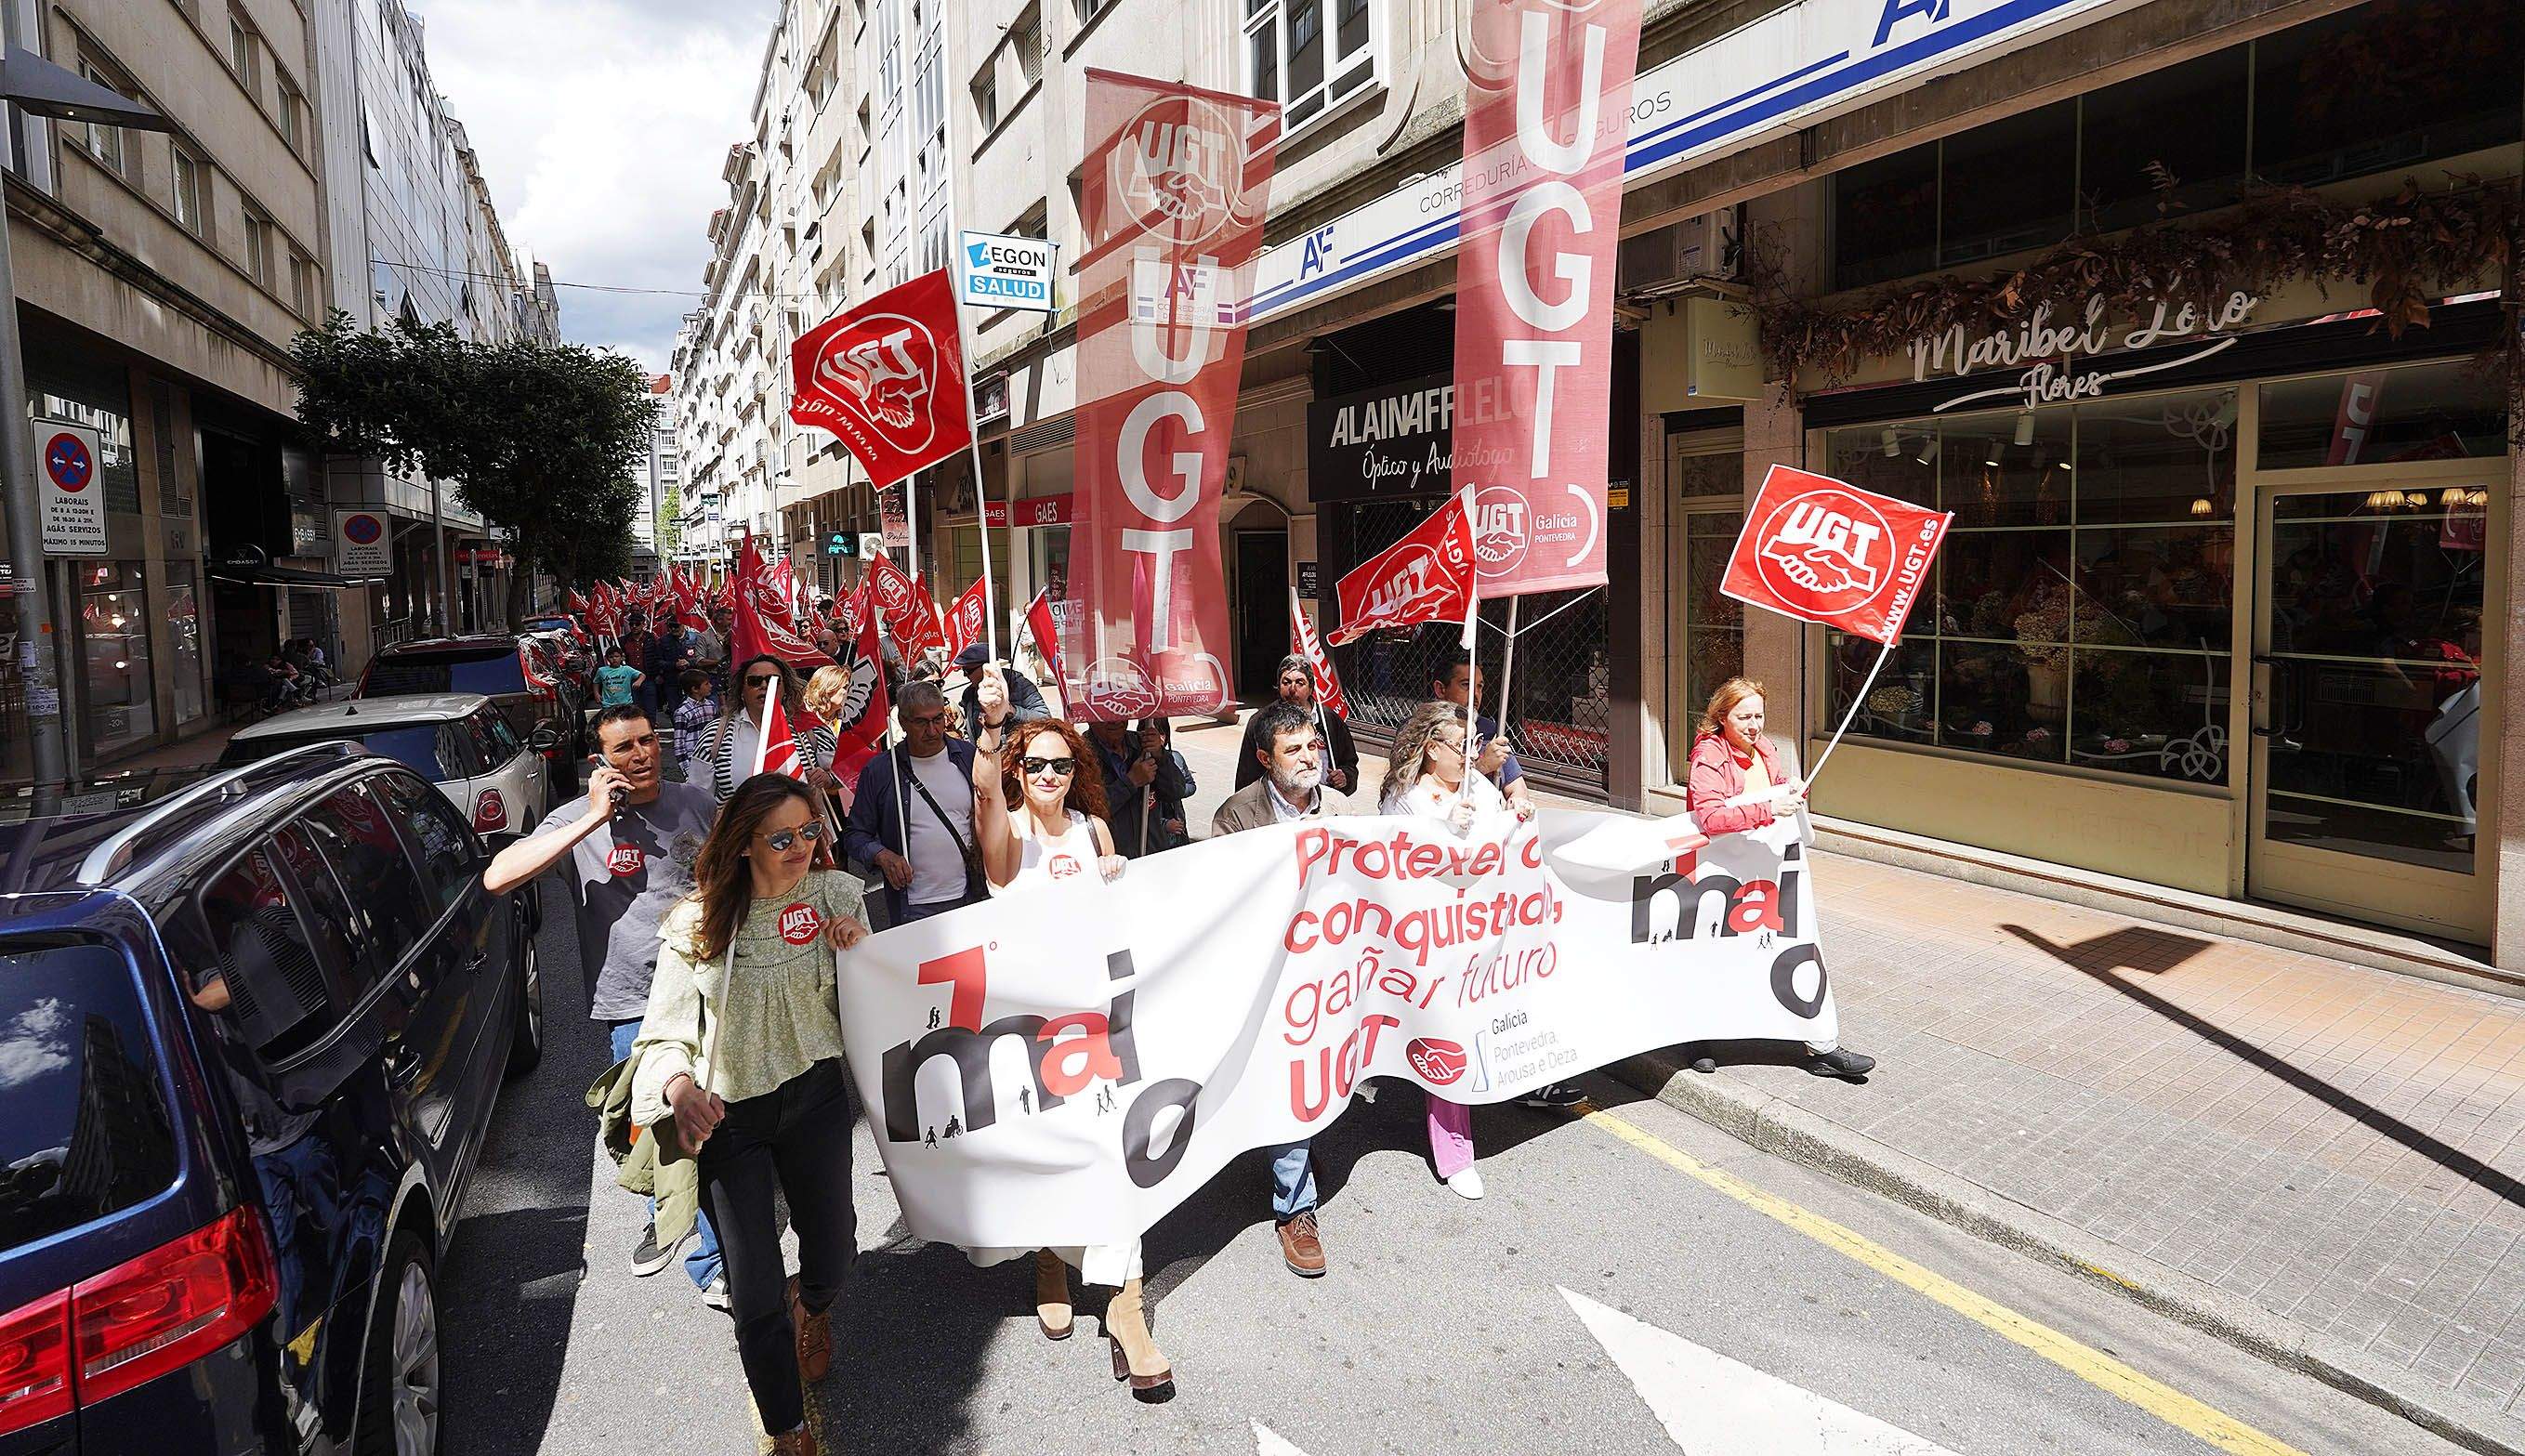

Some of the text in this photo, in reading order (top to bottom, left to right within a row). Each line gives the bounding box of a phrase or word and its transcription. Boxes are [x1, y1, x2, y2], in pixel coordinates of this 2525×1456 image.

[1134, 120, 1226, 186] UGT
[980, 245, 1046, 267] AEGON
[998, 267, 1032, 276] seguros
[1300, 226, 1335, 280] AF
[974, 277, 1042, 297] SALUD
[1907, 294, 2109, 382] Maribel
[822, 328, 920, 400] UGT
[2019, 363, 2111, 409] Flores
[1362, 443, 1408, 490] Óptico
[1413, 459, 1422, 489] y
[55, 497, 89, 505] LABORAIS
[985, 509, 1005, 518] GAES
[1035, 502, 1058, 523] GAES
[1475, 503, 1577, 534] UGT Galicia
[1534, 531, 1576, 544] PONTEVEDRA
[1779, 502, 1880, 569] UGT
[1371, 554, 1428, 615] UGT
[1879, 518, 1939, 640] www.UGT.es
[611, 849, 639, 863] UGT
[782, 907, 815, 930] UGT
[1283, 941, 1557, 1045] gañar futuro
[1492, 1009, 1528, 1035] Galicia
[1291, 1014, 1400, 1122] UGT
[1497, 1060, 1536, 1088] Arousa
[1548, 1046, 1578, 1069] Deza
